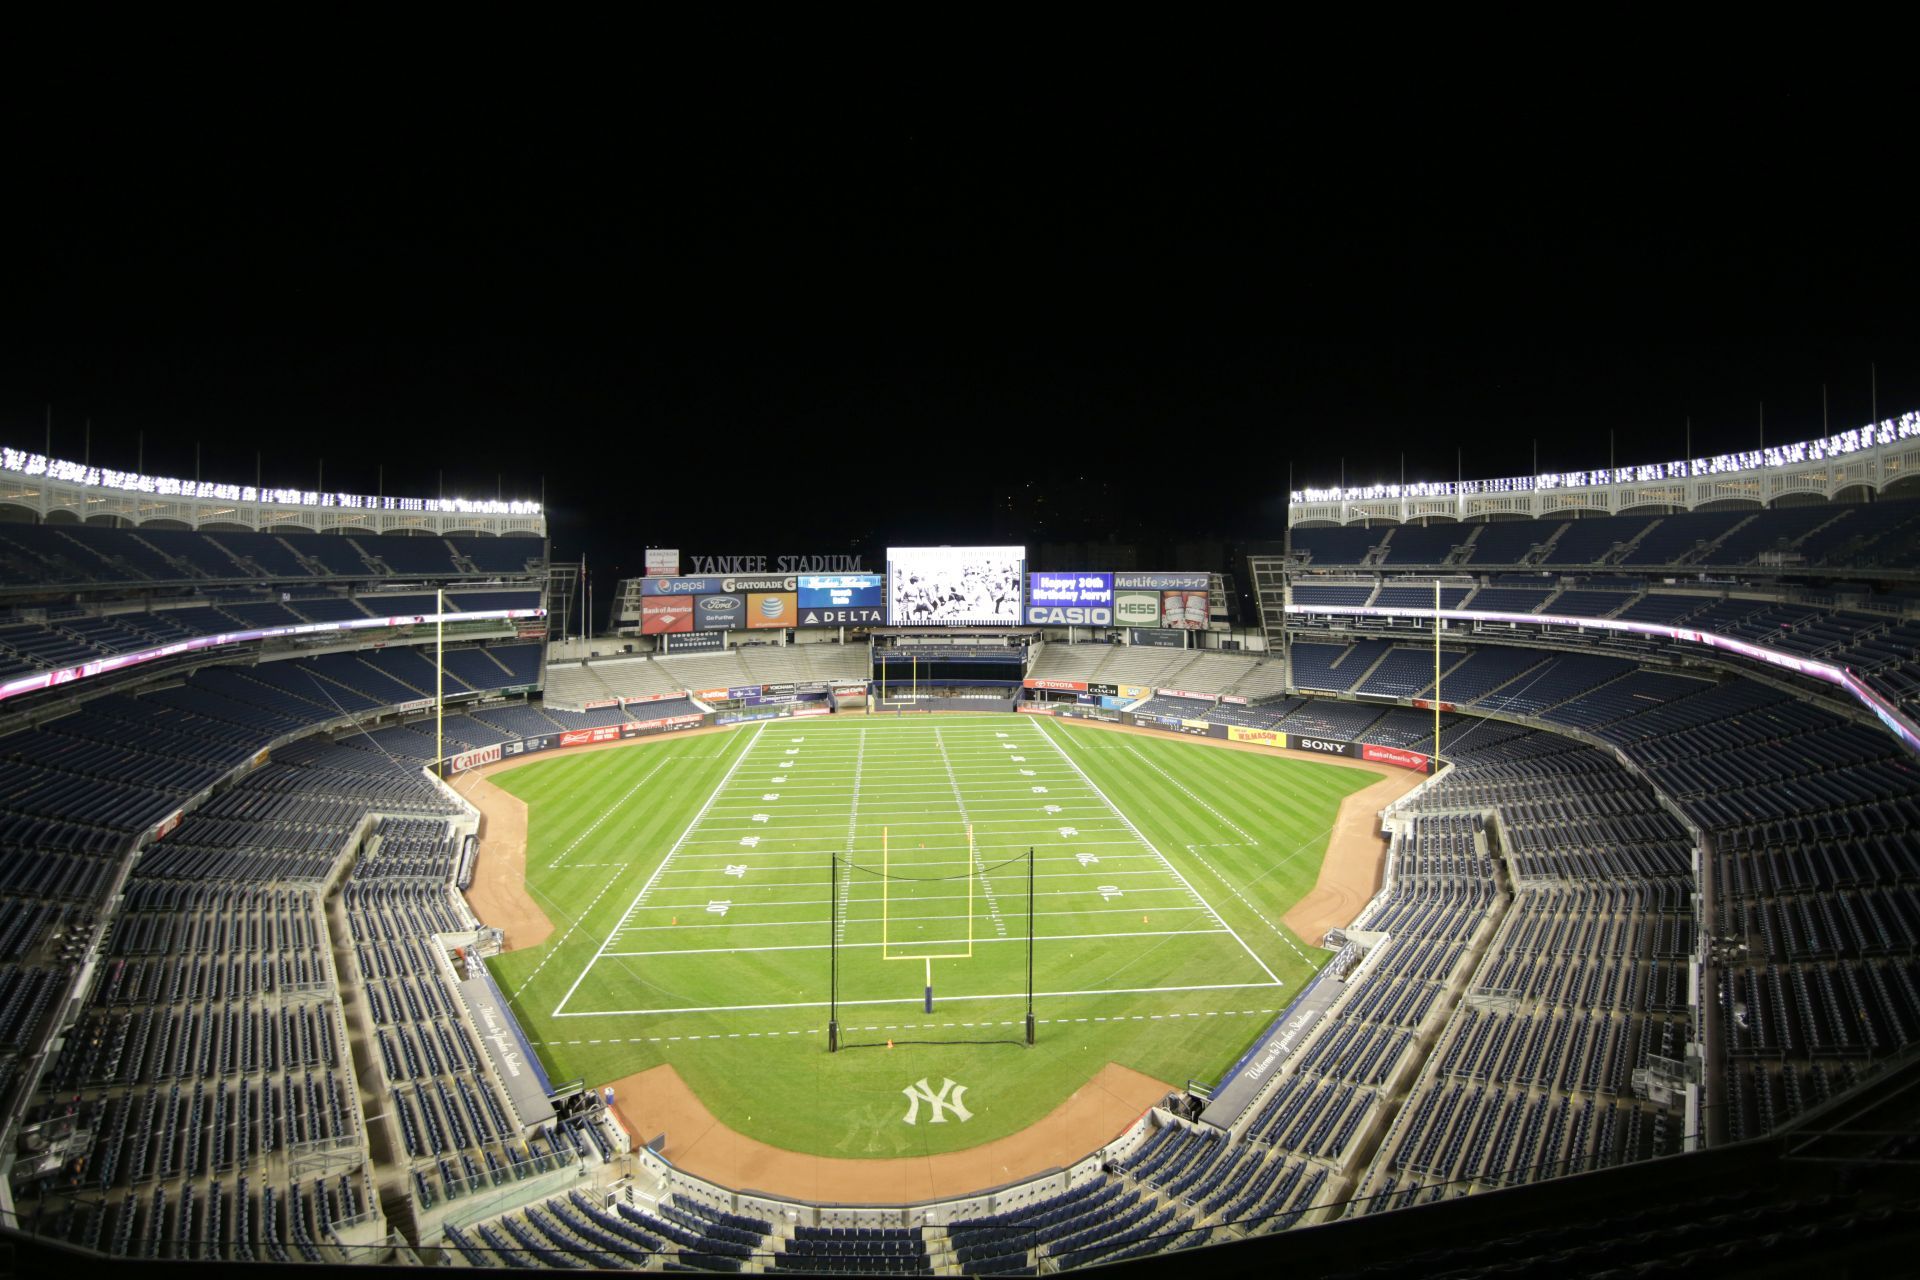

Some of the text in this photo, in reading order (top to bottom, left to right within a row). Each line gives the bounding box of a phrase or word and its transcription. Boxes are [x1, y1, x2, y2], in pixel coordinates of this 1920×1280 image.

[691, 554, 862, 574] YANKEE STADIUM
[673, 580, 706, 592] pepsi
[736, 580, 783, 590] GATORADE
[1114, 576, 1158, 587] MetLife
[1160, 578, 1208, 587] メットライフ
[707, 599, 732, 609] Ford
[1118, 603, 1156, 614] HESS
[824, 610, 881, 622] DELTA
[1029, 607, 1111, 625] CASIO
[1046, 681, 1074, 689] TOYOTA
[1302, 739, 1346, 753] SONY
[453, 748, 500, 771] Canon
[1368, 750, 1383, 758] Bank
[1389, 753, 1411, 763] America
[1244, 1054, 1274, 1080] Welcome
[902, 1077, 975, 1125] NY
